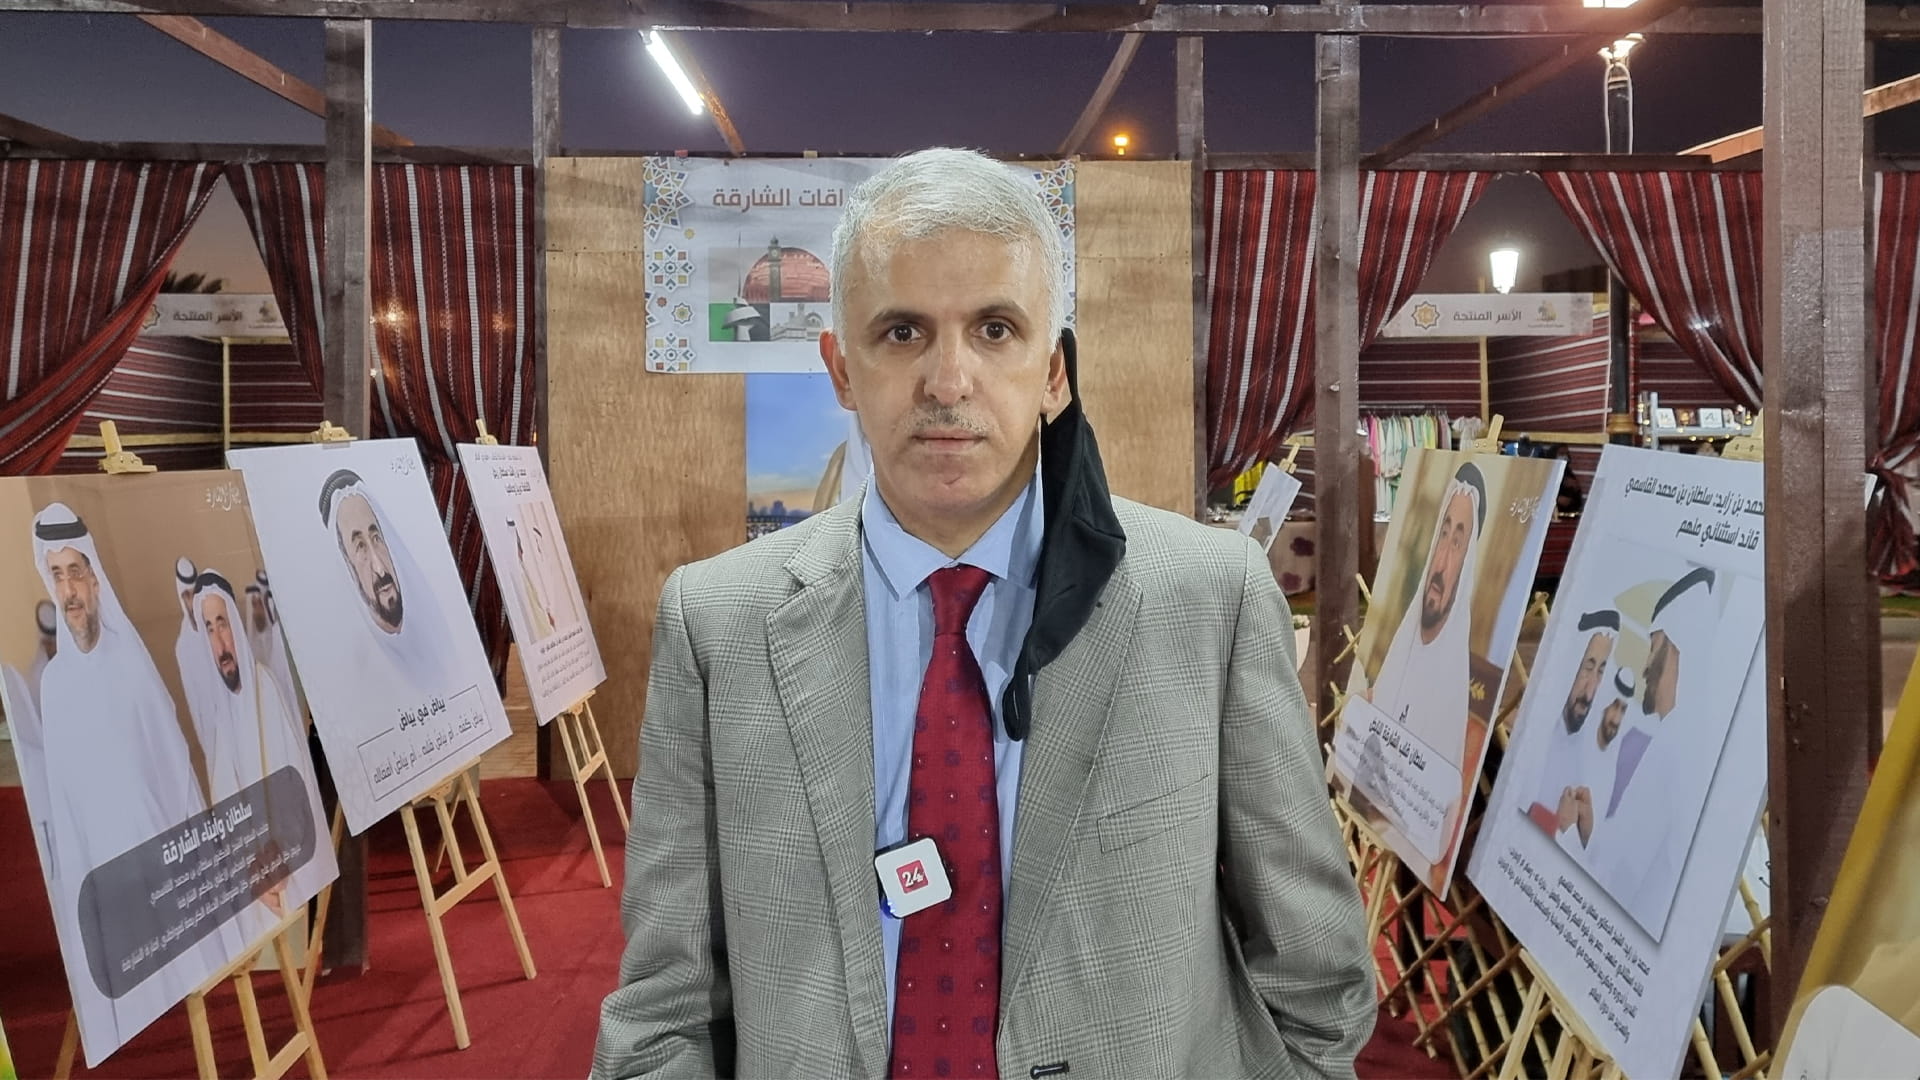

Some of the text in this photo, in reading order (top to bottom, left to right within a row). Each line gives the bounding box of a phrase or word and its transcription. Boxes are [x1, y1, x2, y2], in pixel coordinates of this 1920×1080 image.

[713, 185, 843, 213] اقات الشارقة
[1454, 310, 1522, 324] الأسر المنتجة
[1624, 476, 1658, 497] القاسمي
[1656, 483, 1676, 498] محمد
[1686, 485, 1713, 506] سلطان
[1744, 500, 1764, 515] حمد
[1676, 517, 1760, 550] قائد استثنائي ملهم
[398, 697, 447, 732] بياض في بياض
[162, 802, 252, 865] سلطان وأبناء الشارقة
[902, 867, 924, 887] 24
